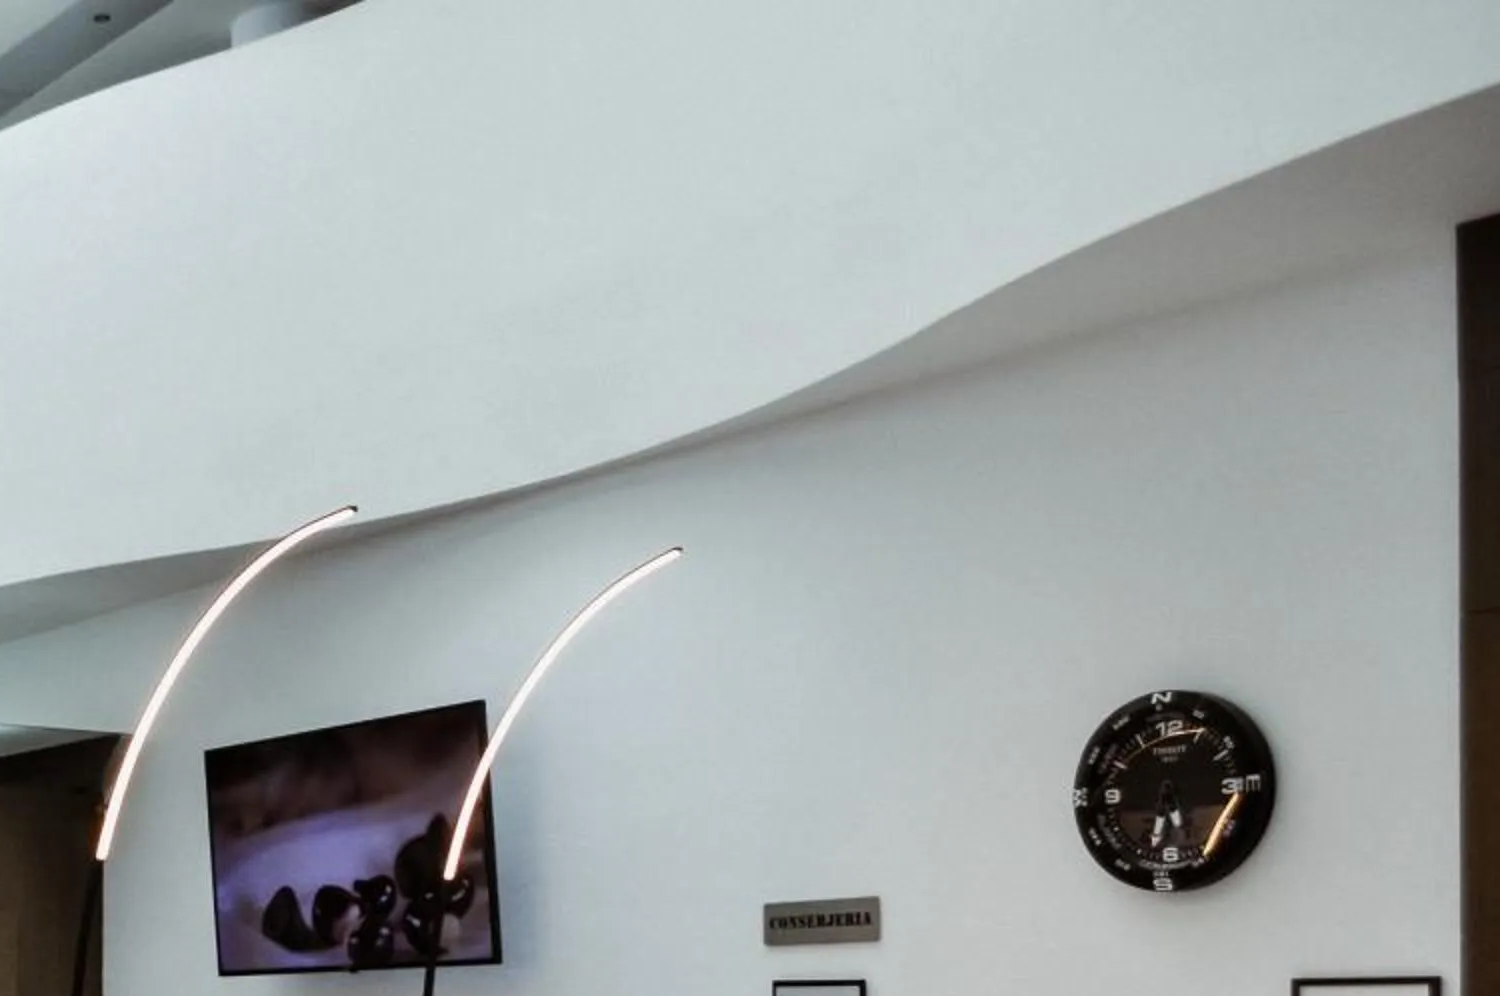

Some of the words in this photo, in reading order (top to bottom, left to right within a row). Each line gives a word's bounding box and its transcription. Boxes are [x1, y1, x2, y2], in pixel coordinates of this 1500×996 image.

[1151, 692, 1172, 704] N
[1155, 720, 1184, 738] 12
[1105, 789, 1121, 805] 9
[1162, 847, 1179, 863] 6
